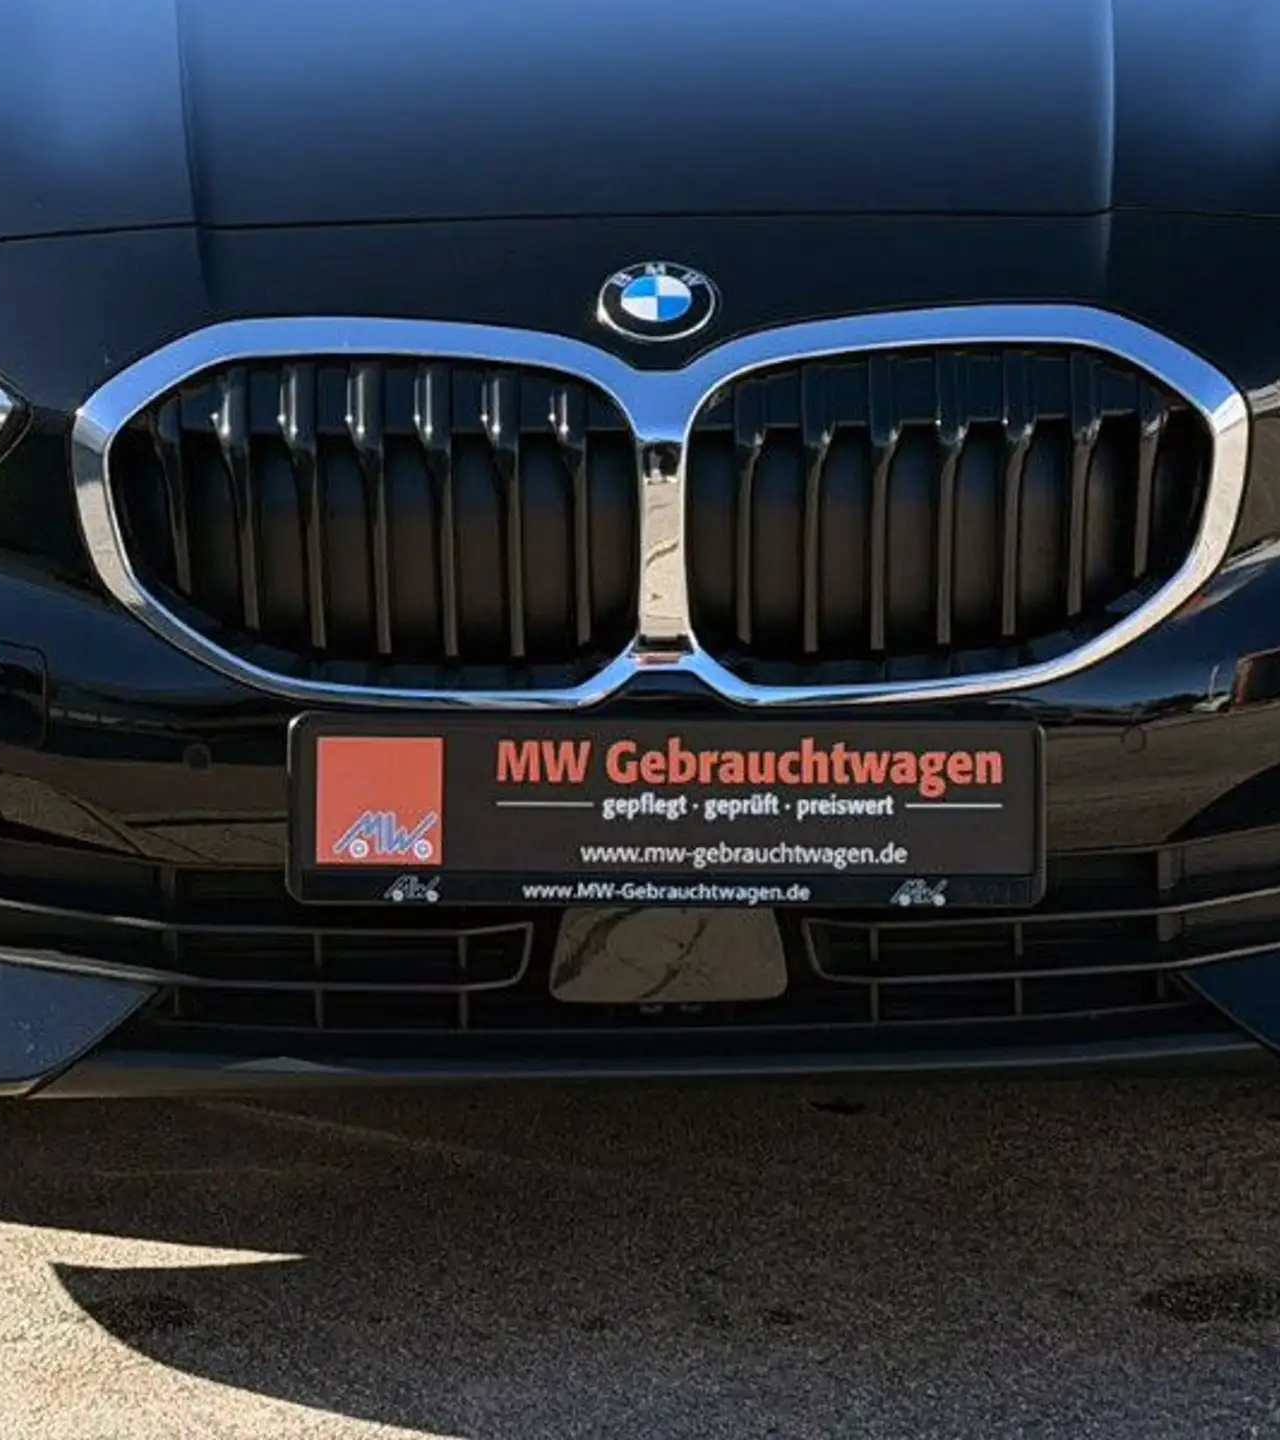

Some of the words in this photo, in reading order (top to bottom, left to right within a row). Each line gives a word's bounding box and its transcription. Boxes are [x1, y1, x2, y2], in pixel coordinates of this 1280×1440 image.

[497, 739, 591, 782] MW
[606, 736, 1003, 797] Gebrauchtwagen
[602, 792, 687, 820] gepflegt
[704, 793, 779, 820] geprüft
[796, 794, 895, 820] preiswert
[580, 841, 909, 869] www.mw-gebrauchtwagen.de
[522, 882, 811, 906] www.MW-Gebrauchtwagen.de
